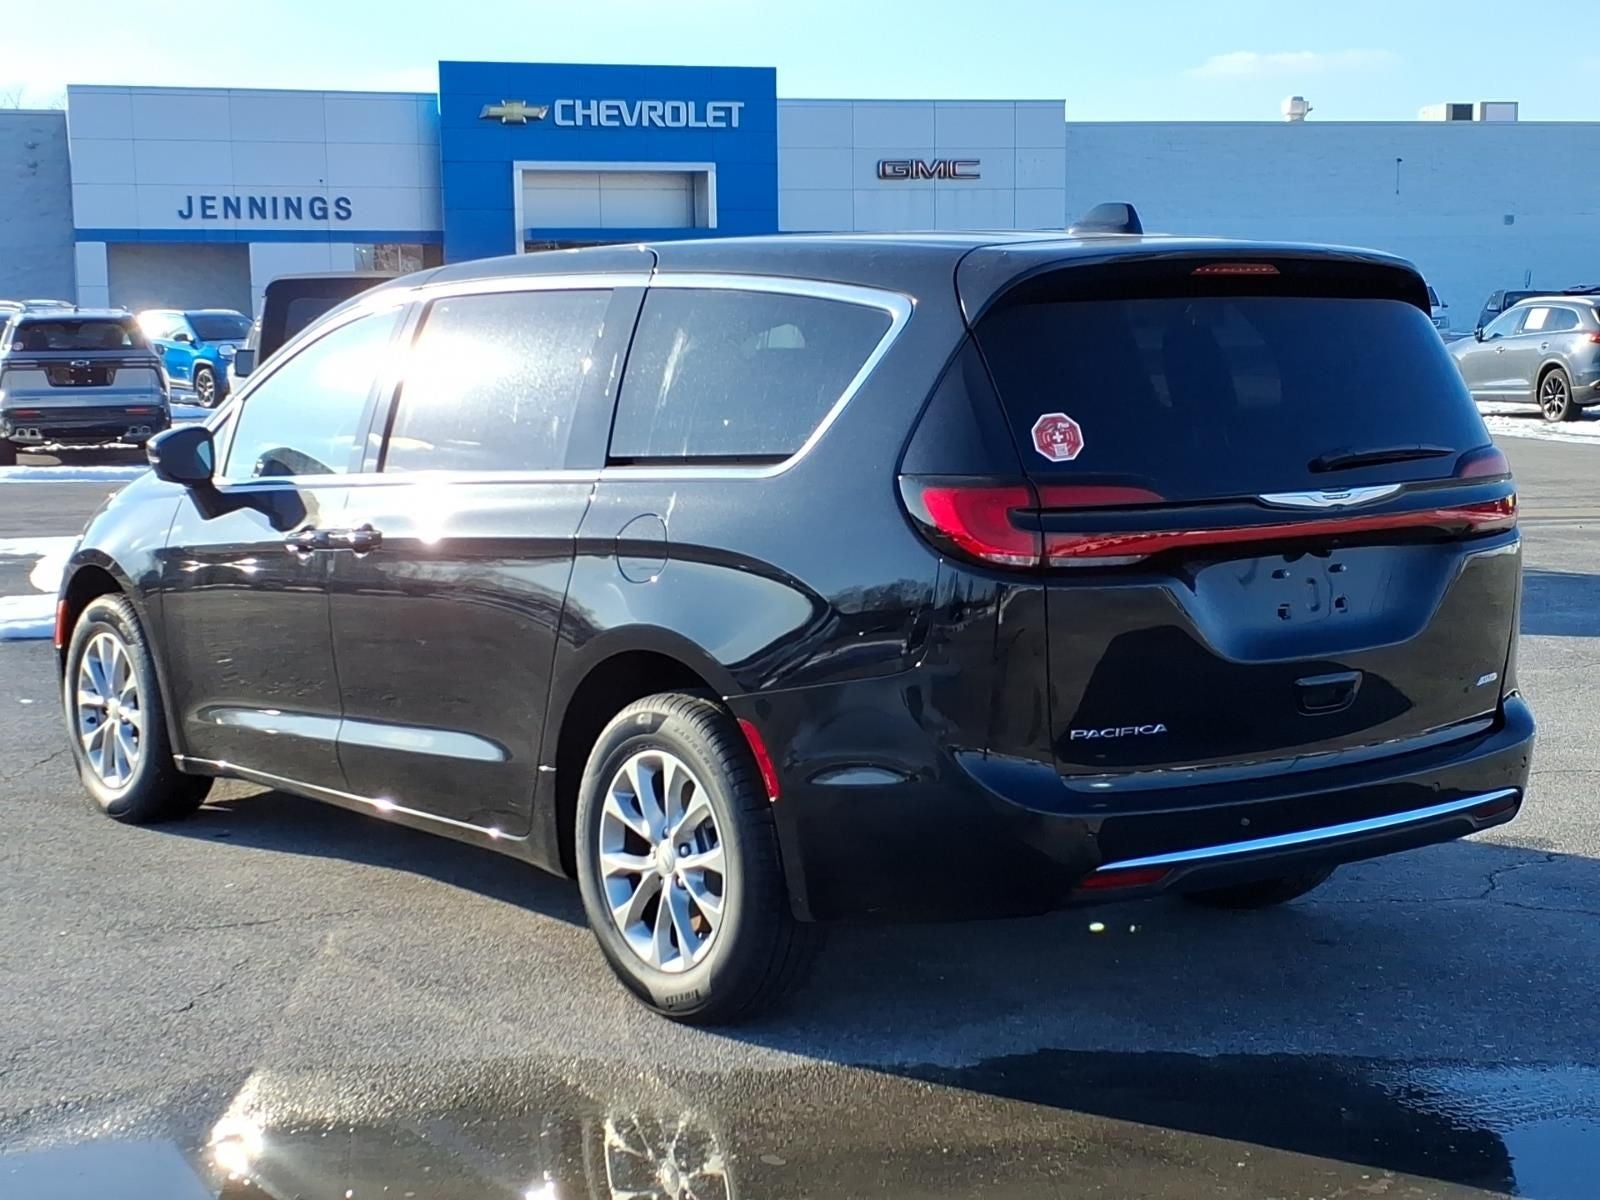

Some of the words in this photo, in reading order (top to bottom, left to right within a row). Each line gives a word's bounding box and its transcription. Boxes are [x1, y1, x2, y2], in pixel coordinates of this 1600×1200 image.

[554, 98, 745, 128] CHEVROLET
[877, 159, 981, 180] GMC
[178, 195, 352, 220] JENNINGS
[1069, 723, 1168, 740] PACIFICA
